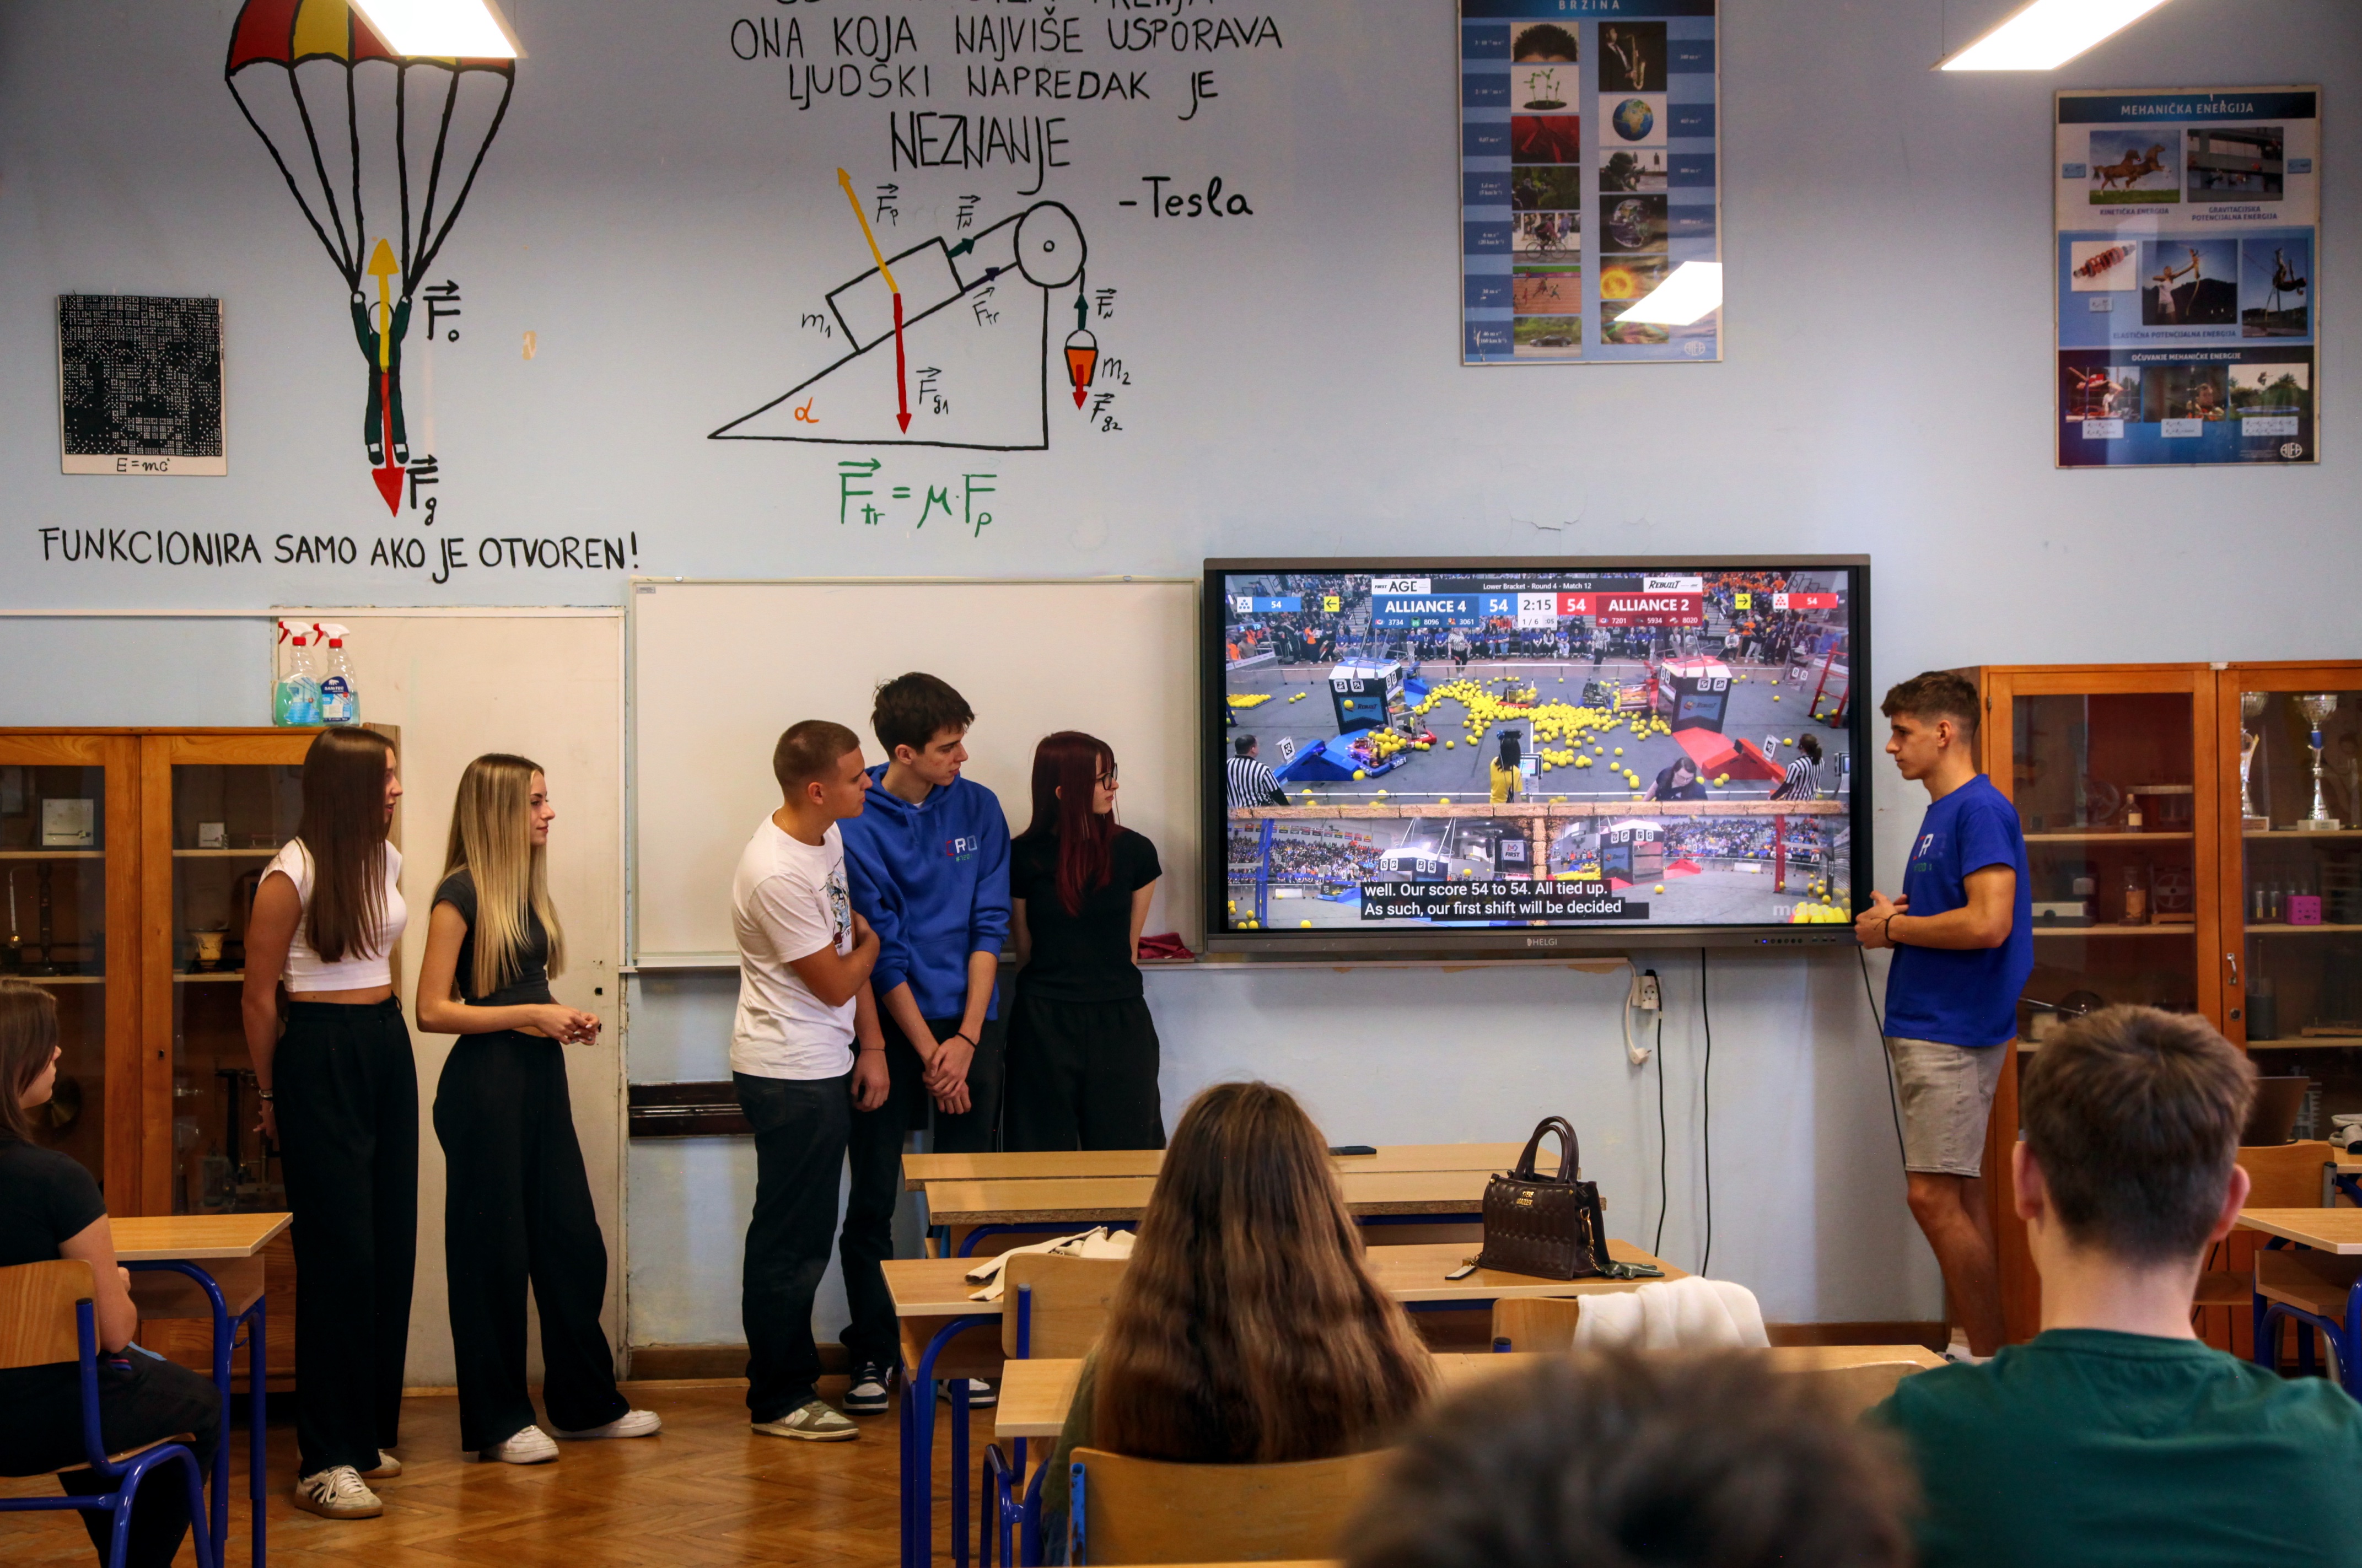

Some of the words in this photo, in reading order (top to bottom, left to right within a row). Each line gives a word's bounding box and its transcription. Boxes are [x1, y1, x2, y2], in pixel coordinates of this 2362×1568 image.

[1559, 0, 1619, 9] BRZINA
[730, 17, 804, 60] ONA
[833, 15, 917, 62] KOJA
[955, 7, 1084, 62] NAJVIŠE
[1107, 16, 1283, 53] USPORAVA
[789, 63, 929, 110] LJUDSKI
[967, 69, 1150, 101] NAPREDAK
[1178, 71, 1219, 121] JE
[2121, 102, 2192, 116] MEHANIČKA
[2197, 102, 2253, 114] ENERGIJA
[890, 111, 1070, 195] NEZNANJE
[2203, 330, 2236, 338] ENERGIJA
[2132, 352, 2167, 362] OČUVANJE
[2169, 352, 2209, 361] MEHANIČKE
[39, 527, 261, 567] FUNKCIONIRA
[275, 534, 357, 564] SAMO
[371, 538, 425, 569] AKO
[433, 538, 468, 584] JE
[480, 531, 638, 570] OTVOREN!
[1648, 580, 1681, 589] REBUILT
[1385, 601, 1454, 613] ALLIANCE
[1457, 600, 1466, 612] 4
[1489, 599, 1509, 612] 54
[1524, 600, 1552, 611] 2:15
[1567, 599, 1586, 611] 54
[1608, 599, 1677, 611] ALLIANCE
[1681, 599, 1689, 611] 2
[1807, 597, 1818, 605] 54
[946, 835, 978, 856] CRO
[1364, 883, 1396, 896] well.
[1400, 883, 1425, 896] Our
[1429, 885, 1467, 896] score
[1471, 883, 1489, 896] 54
[1492, 883, 1506, 896] to
[1510, 882, 1531, 896] 54.
[1535, 882, 1553, 895] All
[1556, 881, 1583, 895] tied
[1586, 883, 1608, 897] up.
[1364, 903, 1384, 915] As
[1387, 901, 1424, 917] such,
[1427, 903, 1450, 915] our
[1454, 901, 1481, 914] first
[1484, 900, 1516, 914] shift
[1519, 900, 1543, 914] will
[1546, 901, 1563, 914] be
[1567, 899, 1622, 913] decided
